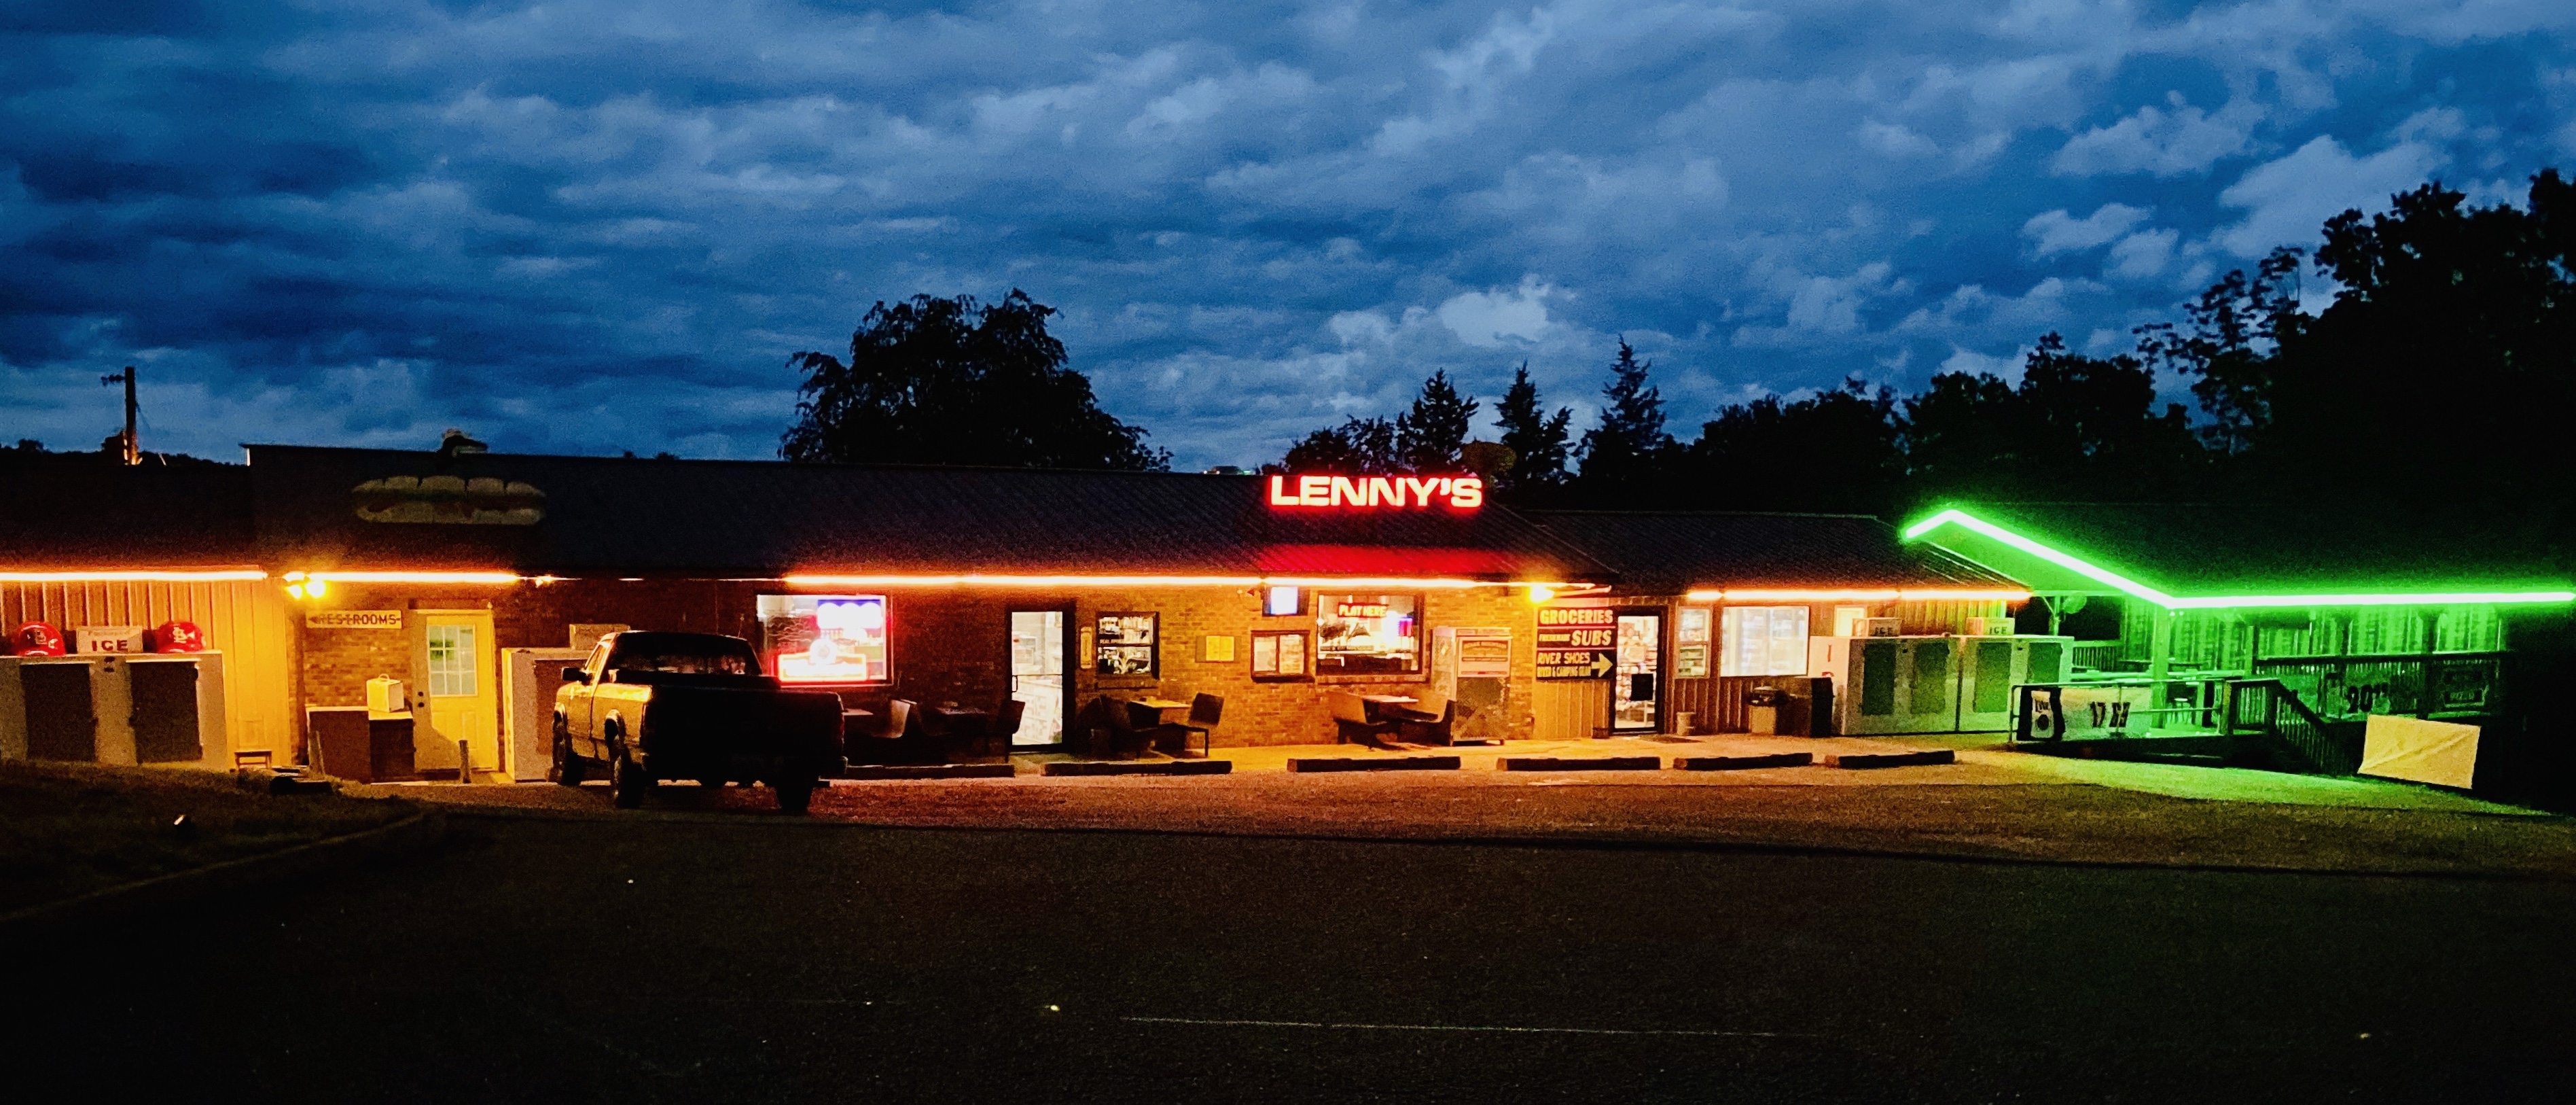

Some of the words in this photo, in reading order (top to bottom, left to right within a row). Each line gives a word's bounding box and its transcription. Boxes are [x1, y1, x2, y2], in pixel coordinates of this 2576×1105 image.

[1271, 476, 1482, 507] LENNY'S
[1338, 604, 1361, 616] PLAY
[1363, 606, 1387, 616] HERE
[319, 613, 396, 625] RESTROOMS
[1539, 610, 1613, 625] GROCERIES
[1875, 627, 1893, 636] ICE
[1989, 627, 2007, 635] ICE
[1571, 630, 1612, 646] SUBS
[91, 639, 128, 652] ICE
[1537, 652, 1562, 665] RIVER
[1564, 652, 1590, 664] SHOES
